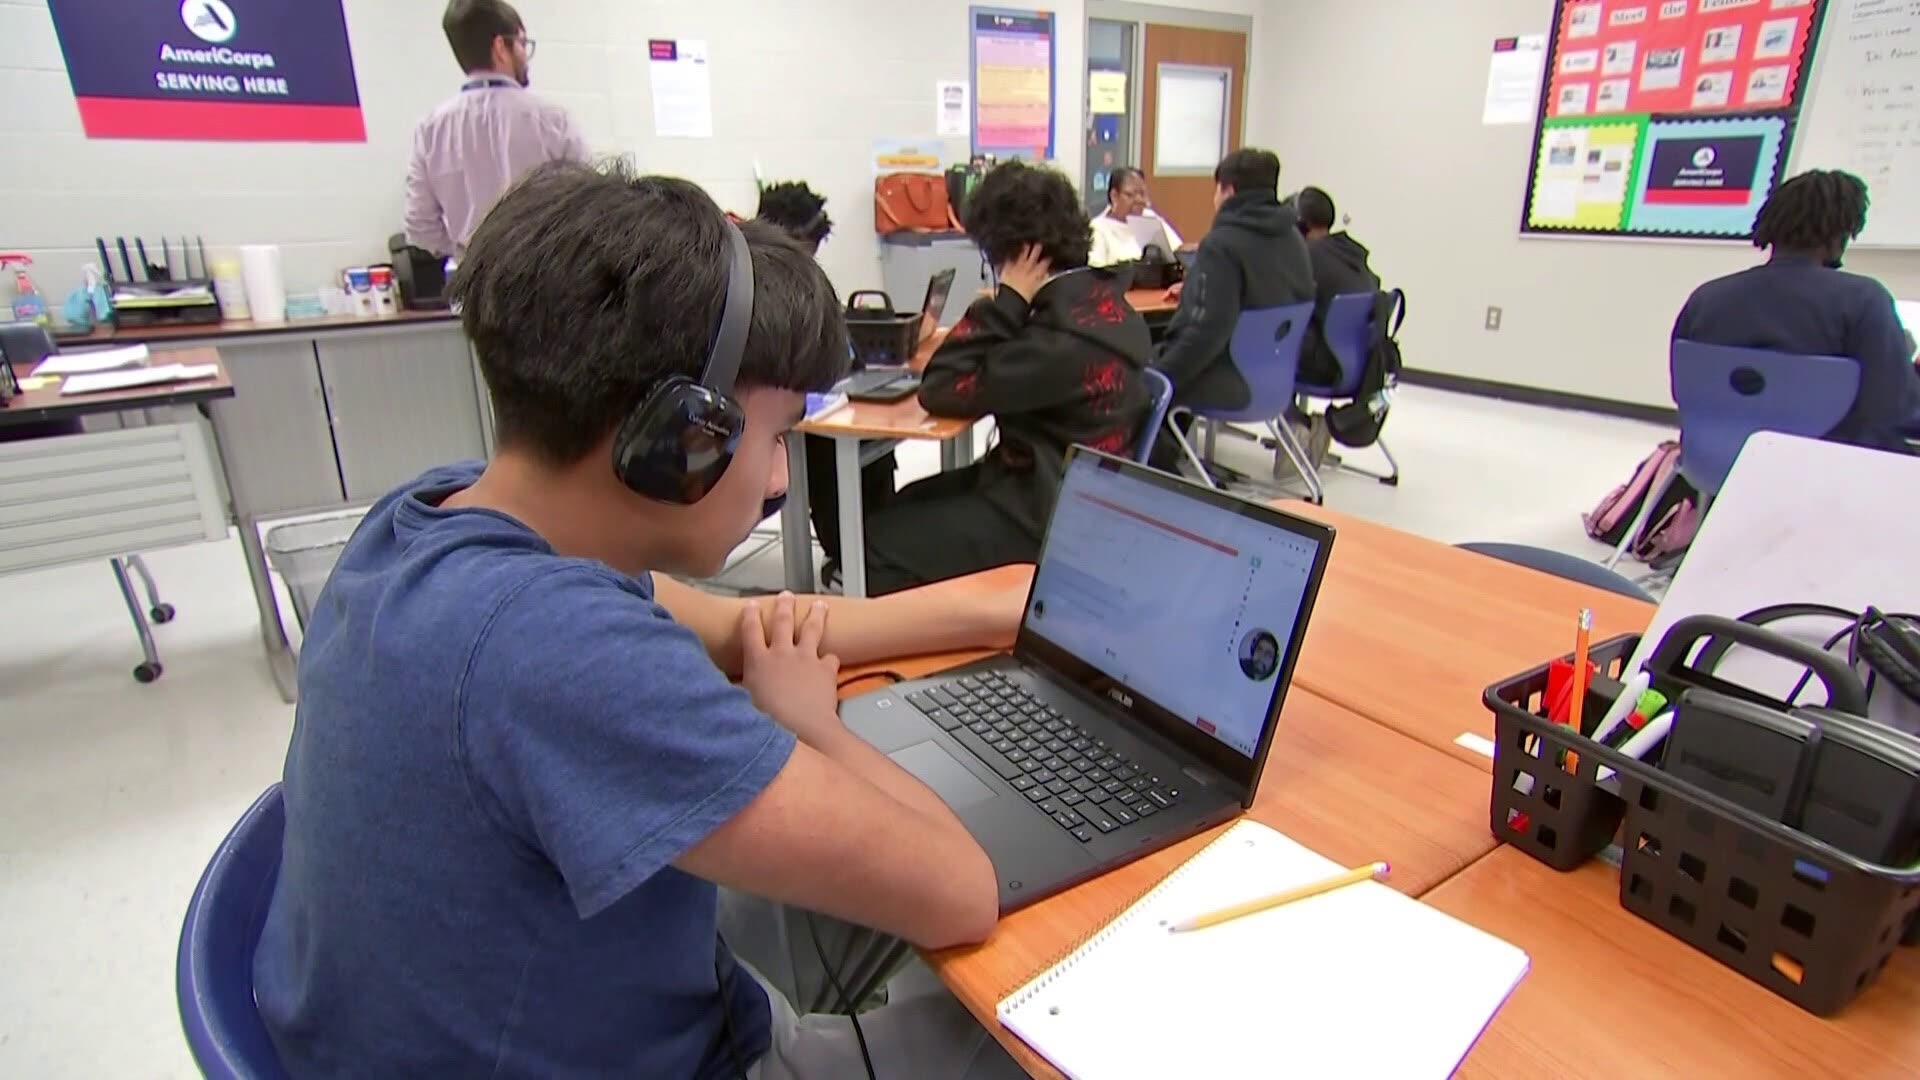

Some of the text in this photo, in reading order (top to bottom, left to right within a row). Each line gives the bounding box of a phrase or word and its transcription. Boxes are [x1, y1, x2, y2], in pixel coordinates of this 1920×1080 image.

[160, 43, 275, 70] AmeriCorps
[155, 71, 288, 95] SERVING HERE
